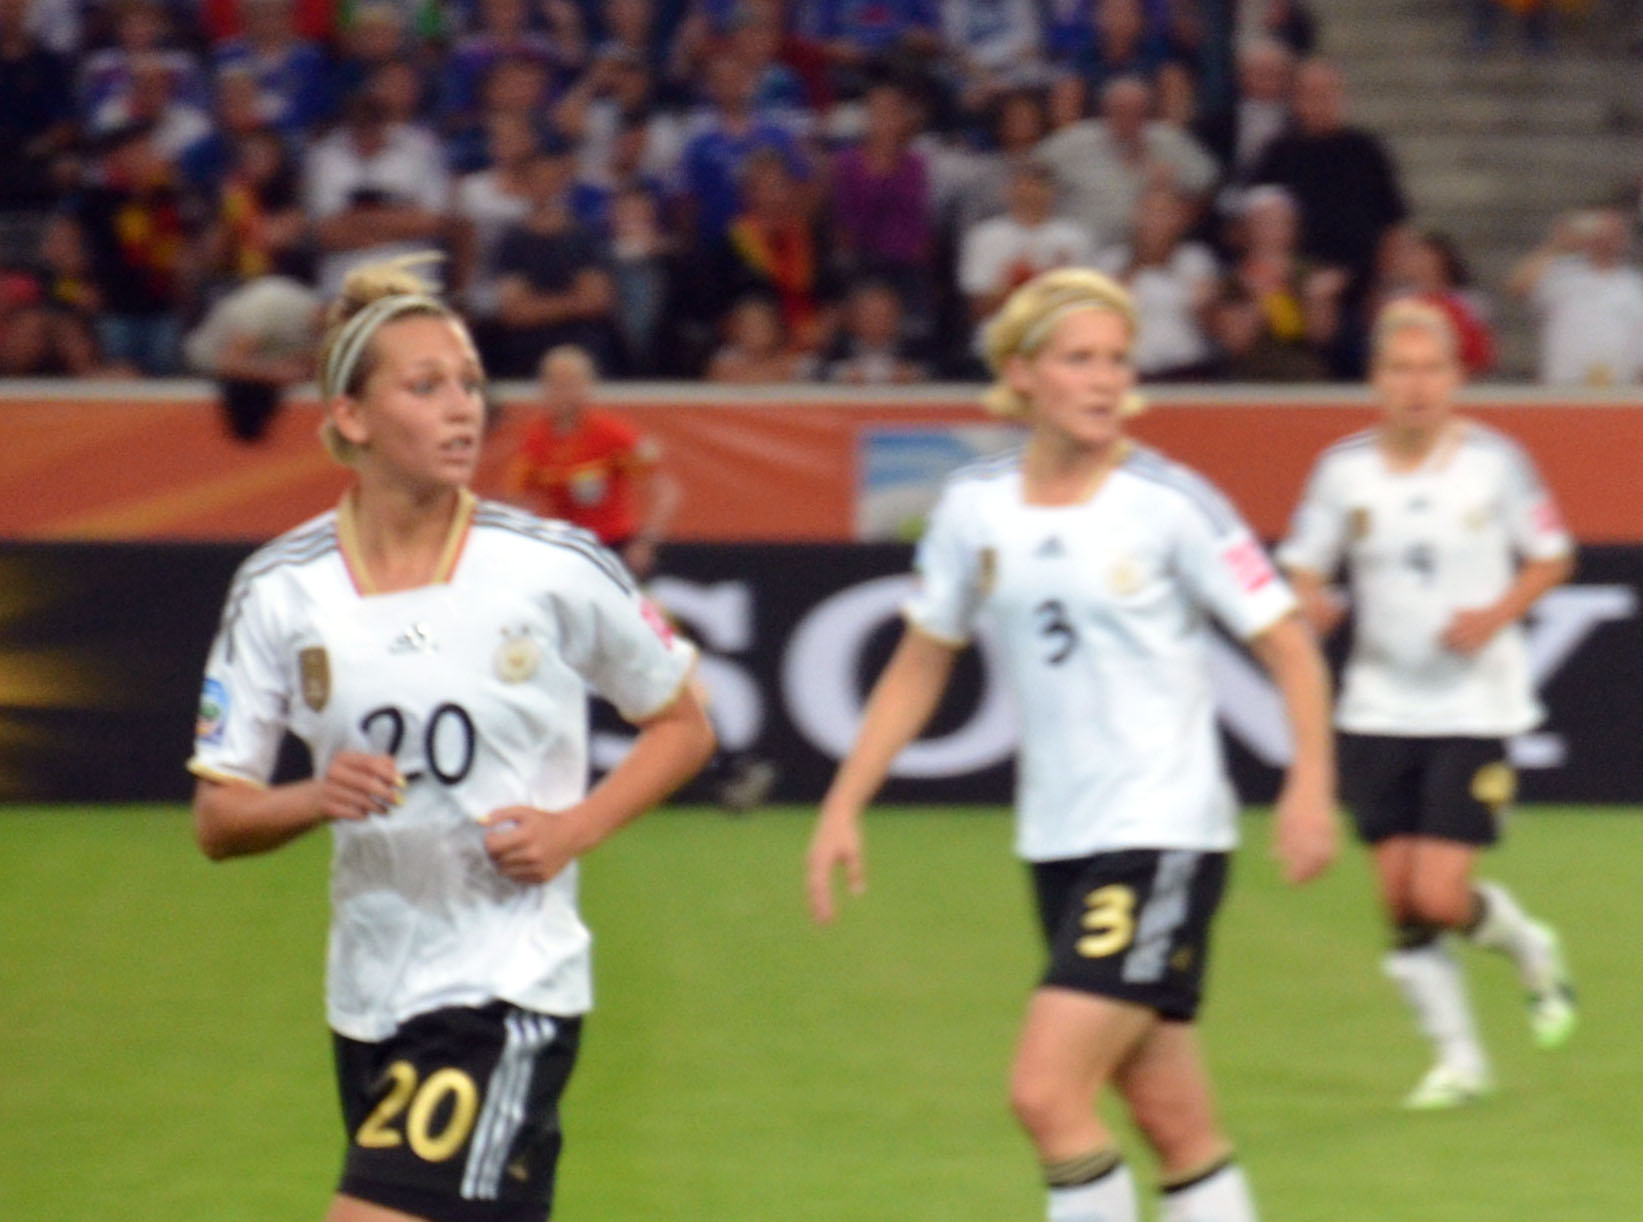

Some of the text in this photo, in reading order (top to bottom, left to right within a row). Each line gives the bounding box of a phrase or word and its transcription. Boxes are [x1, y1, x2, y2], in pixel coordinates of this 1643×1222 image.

[1034, 597, 1081, 667] 3
[592, 573, 1637, 778] SO
[360, 703, 475, 786] 20
[1074, 883, 1138, 958] 3
[356, 1060, 478, 1162] 20
